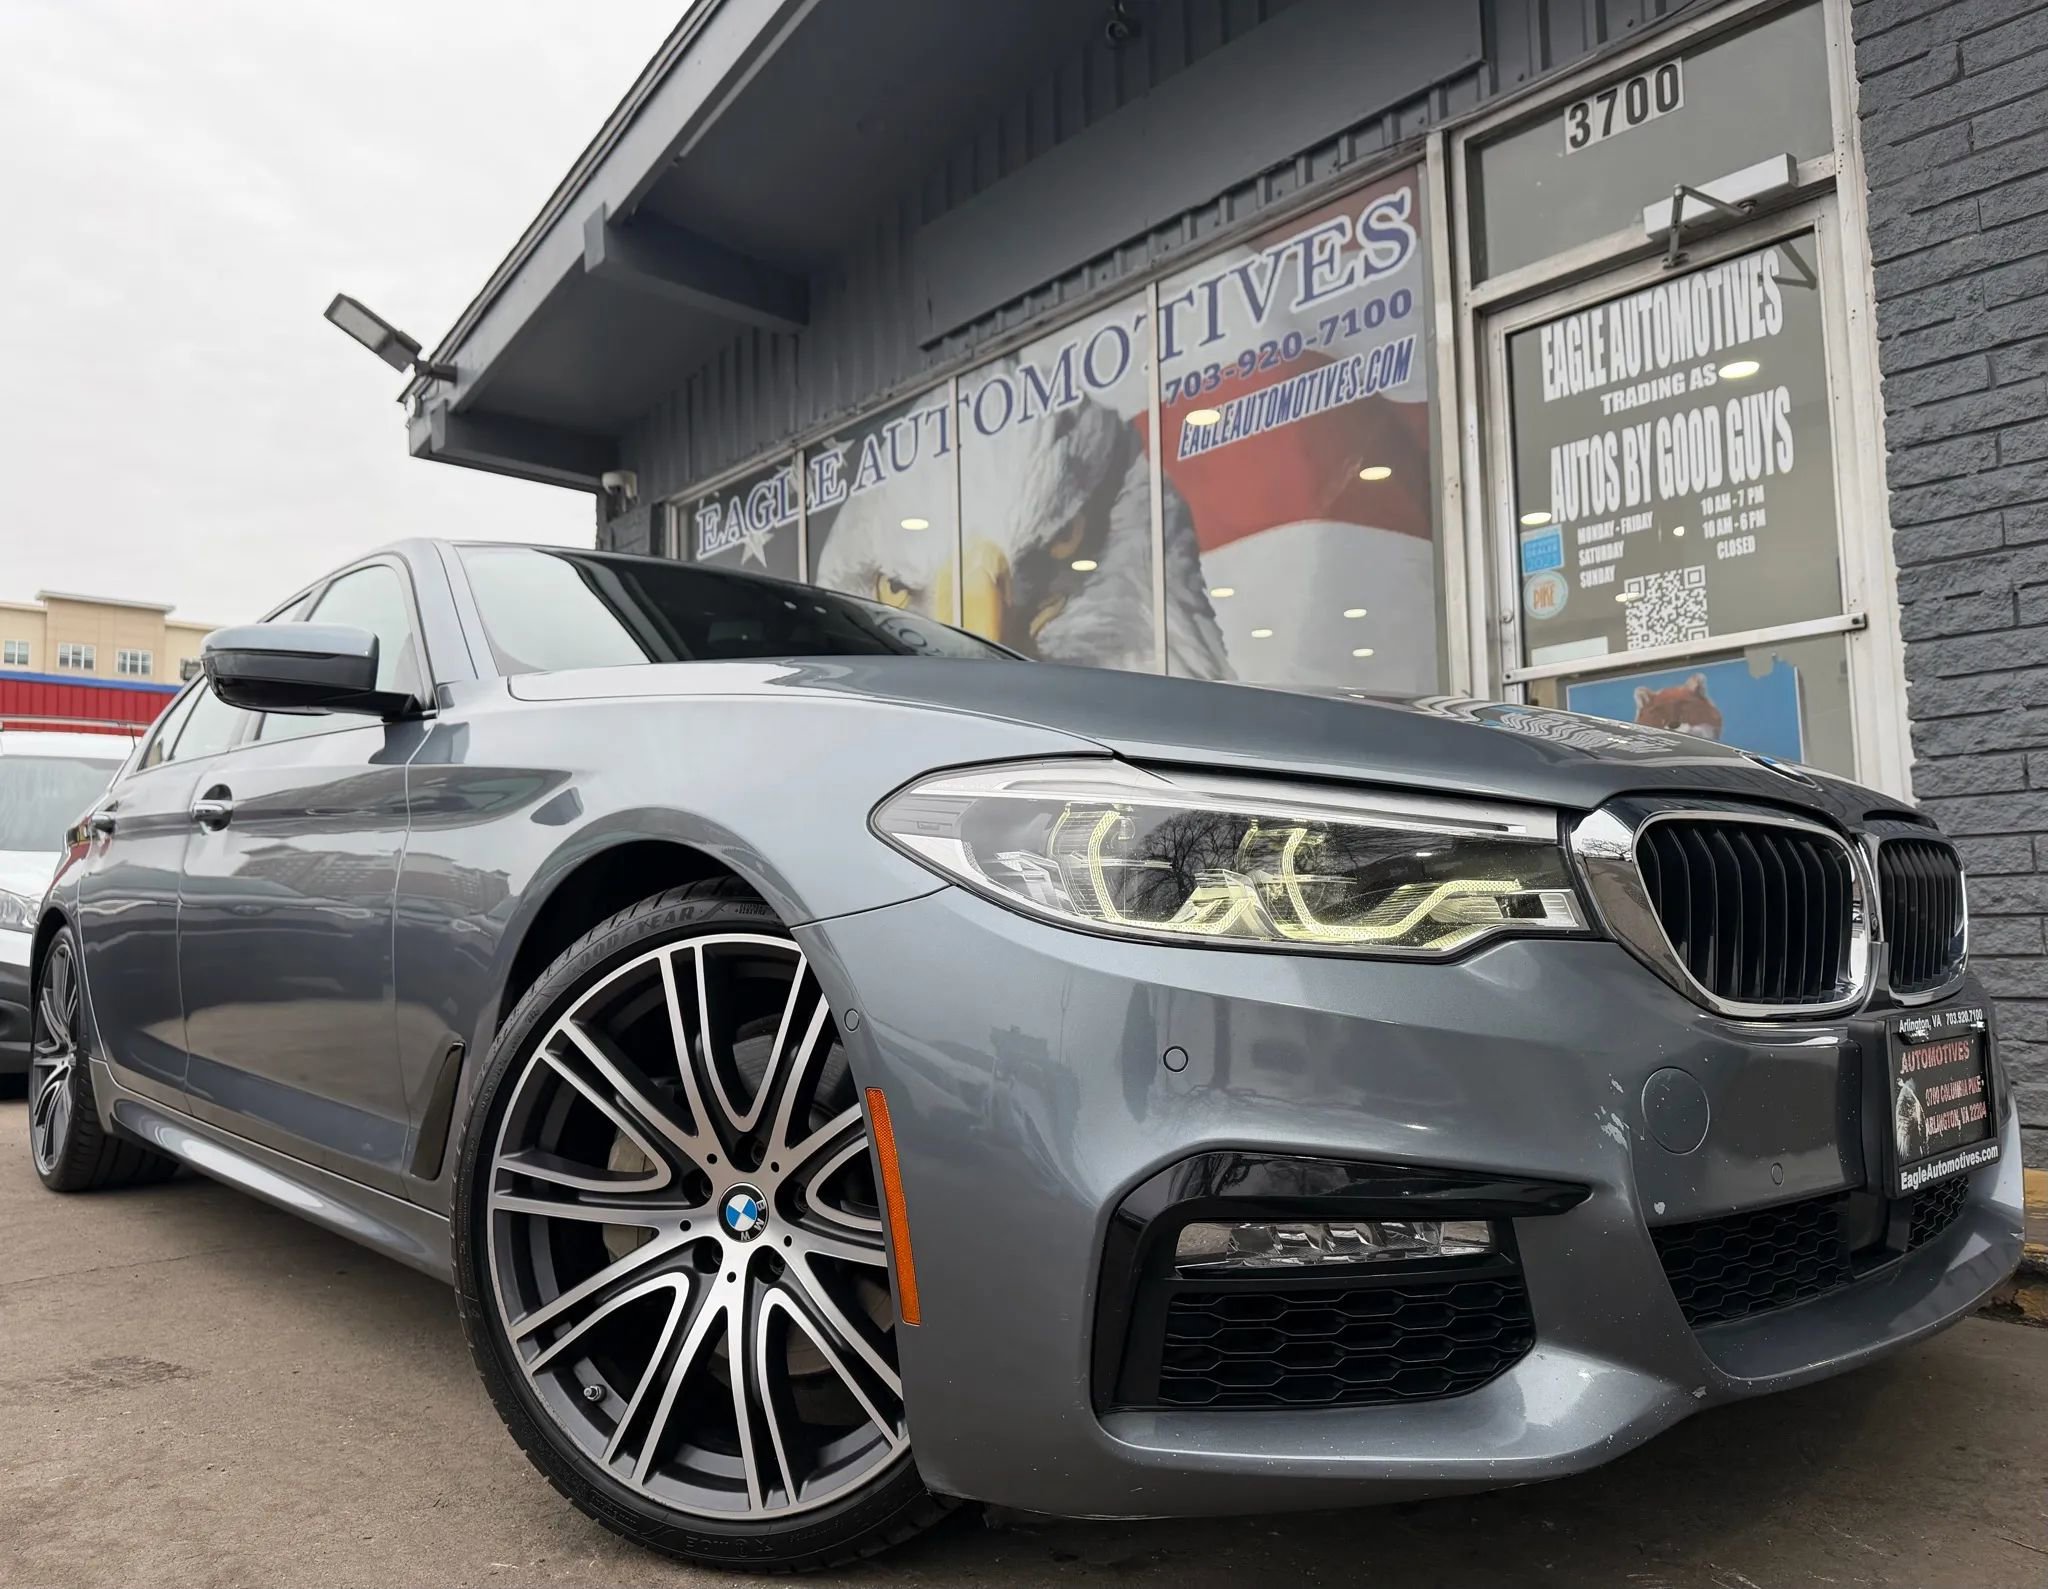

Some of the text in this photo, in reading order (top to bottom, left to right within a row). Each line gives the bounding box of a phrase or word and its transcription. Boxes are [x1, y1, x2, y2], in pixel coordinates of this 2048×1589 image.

[1568, 63, 1680, 150] 3700
[1164, 288, 1412, 405] 703-920-7100
[1540, 250, 1784, 403] EAGLE AUTOMOTIVES
[695, 187, 1417, 560] EAGLE AUTOMOTIVES
[1600, 363, 1718, 416] TRADING AS
[1178, 336, 1415, 460] EAGLEAUTOMOTIVES.COM
[1551, 385, 1795, 524] AUTOS BY GOOD GUYS
[1701, 496, 1714, 516] 10
[1714, 492, 1732, 514] AM
[1737, 488, 1745, 507] 7
[1747, 484, 1765, 506] PM
[1577, 519, 1616, 546] MONDAY
[1620, 511, 1653, 535] FRIDAY
[1702, 520, 1716, 539] 10
[1716, 516, 1734, 536] AM
[1740, 511, 1748, 531] 6
[1748, 508, 1767, 530] PM
[1578, 540, 1624, 567] SATURDAY
[1716, 535, 1756, 560] CLOSED
[1579, 564, 1616, 589] SUNDAY
[1899, 1008, 1983, 1033] Arlington, VA 703.920.7100
[1900, 1040, 1970, 1075] AUTOMOTIVES
[1900, 1145, 1999, 1190] EagleAutomotives.com
[740, 1199, 767, 1241] BMW
